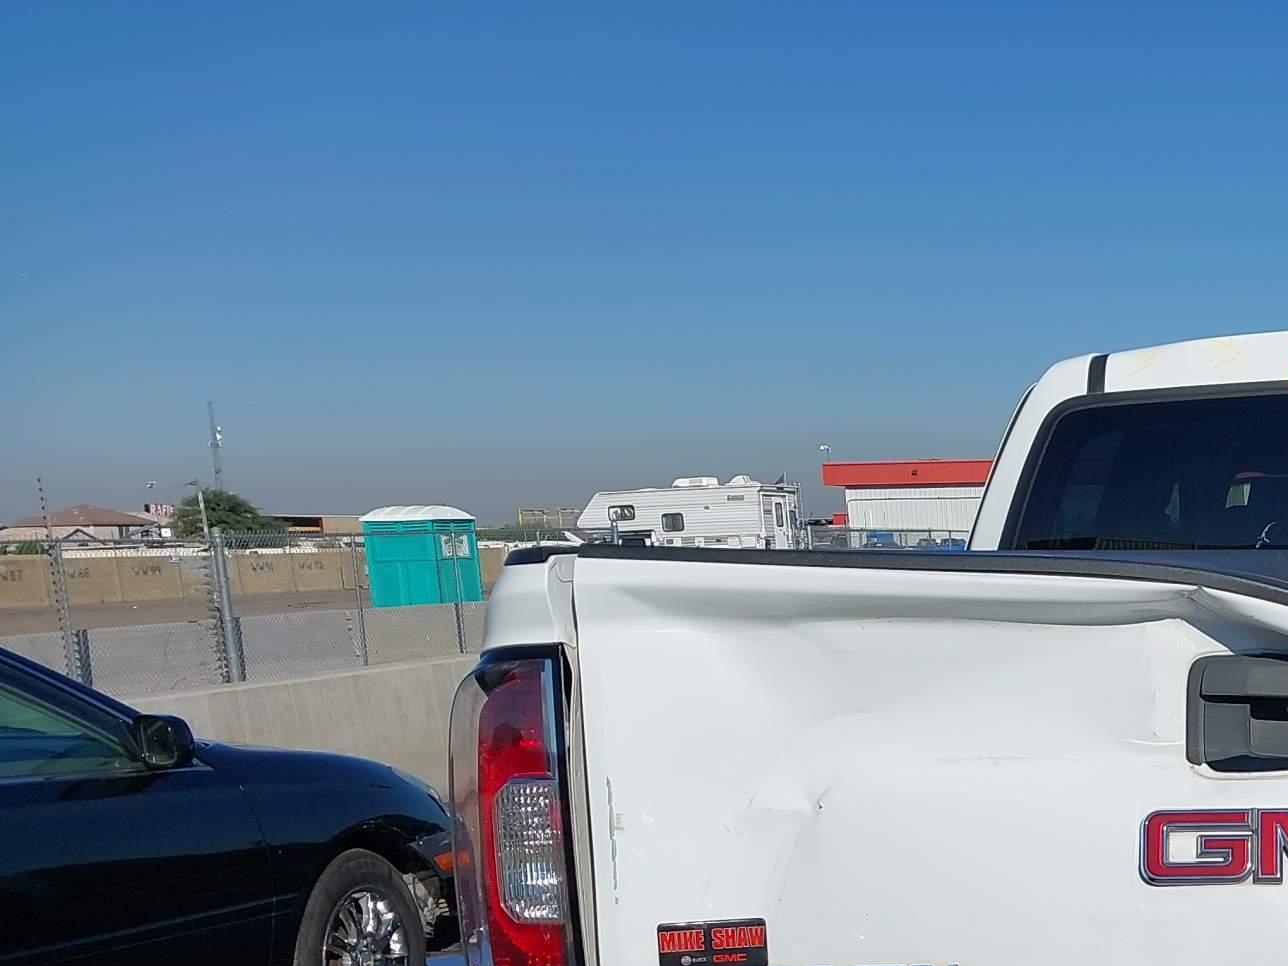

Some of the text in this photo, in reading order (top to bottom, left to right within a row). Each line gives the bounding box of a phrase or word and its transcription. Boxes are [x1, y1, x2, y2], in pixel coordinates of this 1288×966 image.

[659, 926, 764, 953] MIKE SHAW
[713, 954, 747, 963] GMC
